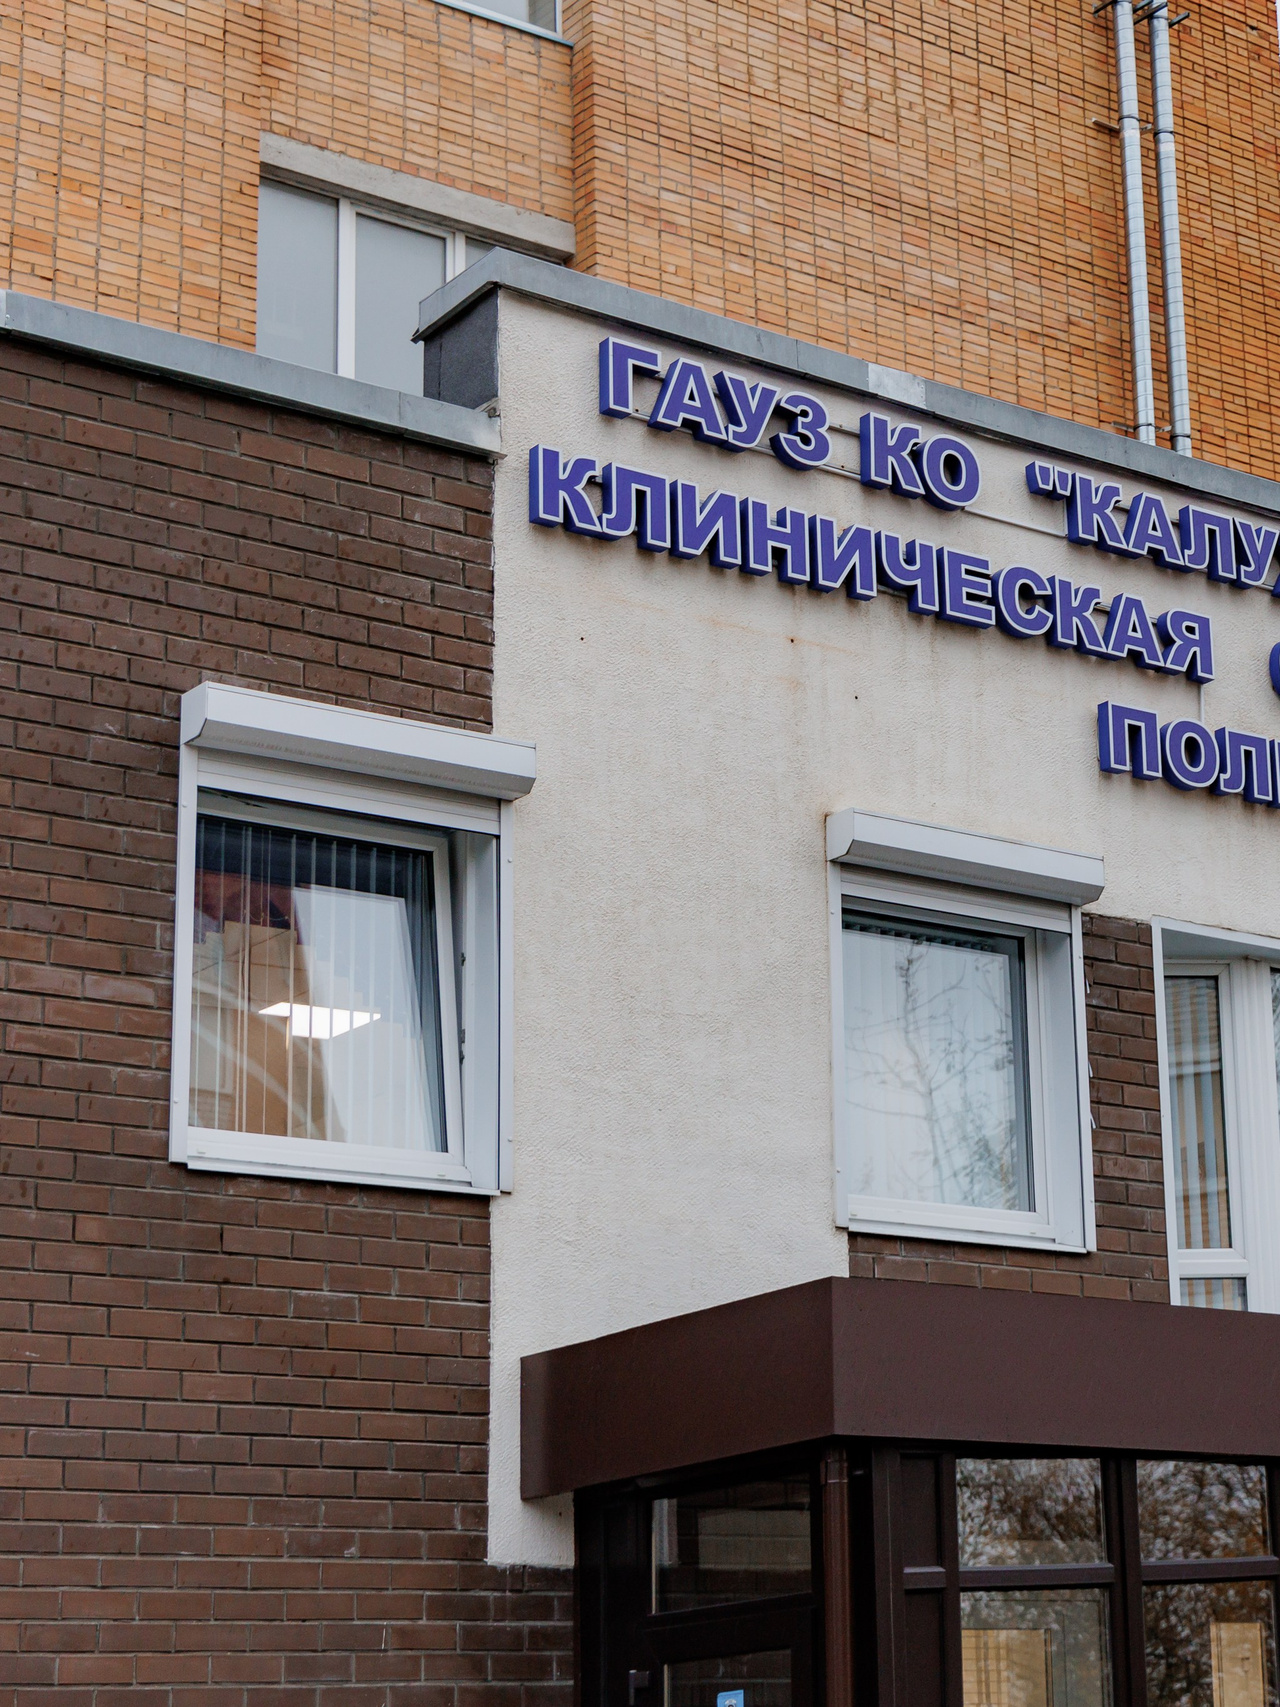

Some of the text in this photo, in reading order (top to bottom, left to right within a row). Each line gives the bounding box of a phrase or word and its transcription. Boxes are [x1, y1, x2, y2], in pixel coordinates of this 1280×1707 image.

[600, 336, 834, 471] ГАУЗ
[859, 411, 982, 511] КО
[529, 443, 1215, 684] КЛИНИЧЕСКАЯ
